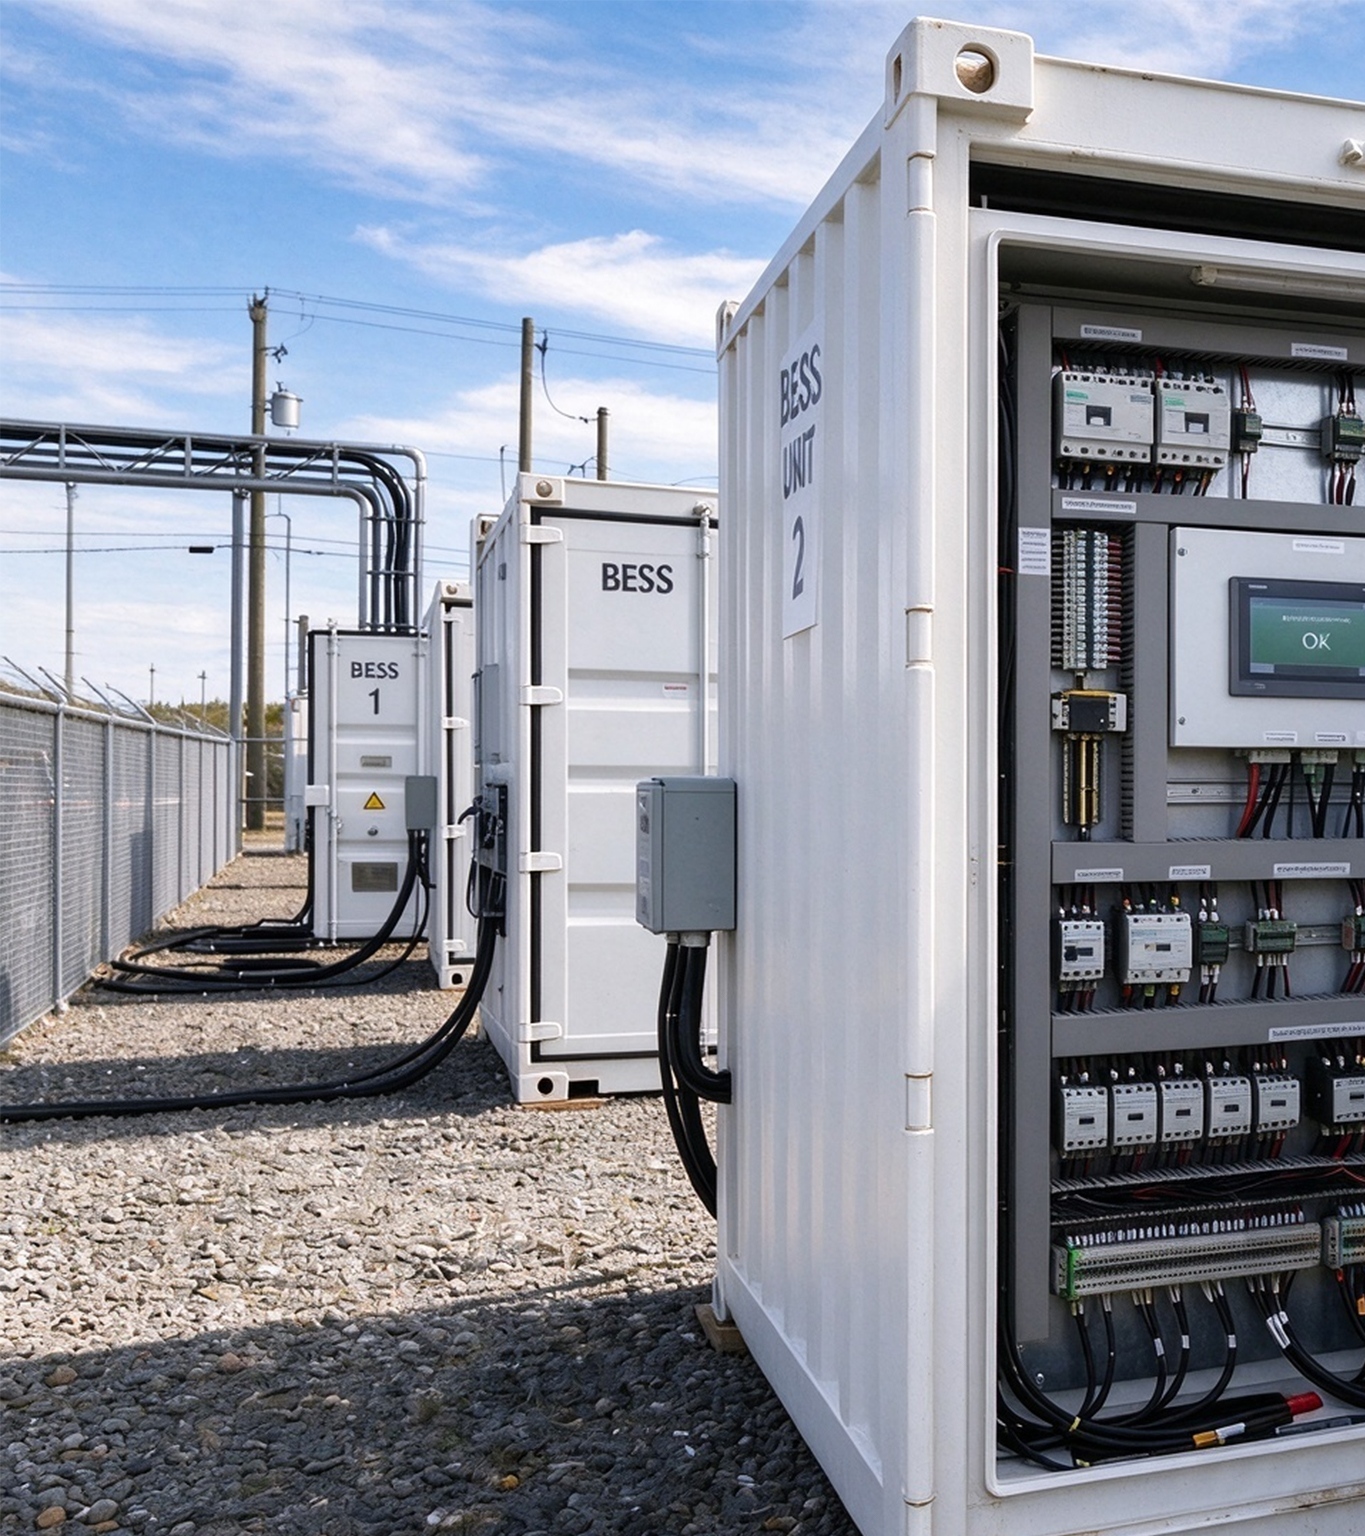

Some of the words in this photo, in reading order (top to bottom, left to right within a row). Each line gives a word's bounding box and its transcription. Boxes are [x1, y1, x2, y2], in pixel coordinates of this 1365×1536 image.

[780, 343, 822, 428] BESS
[783, 424, 816, 500] UNIT
[792, 515, 805, 600] 2
[602, 562, 674, 594] BESS
[1302, 632, 1331, 650] OK
[351, 661, 399, 679] BESS
[368, 687, 379, 715] 1
